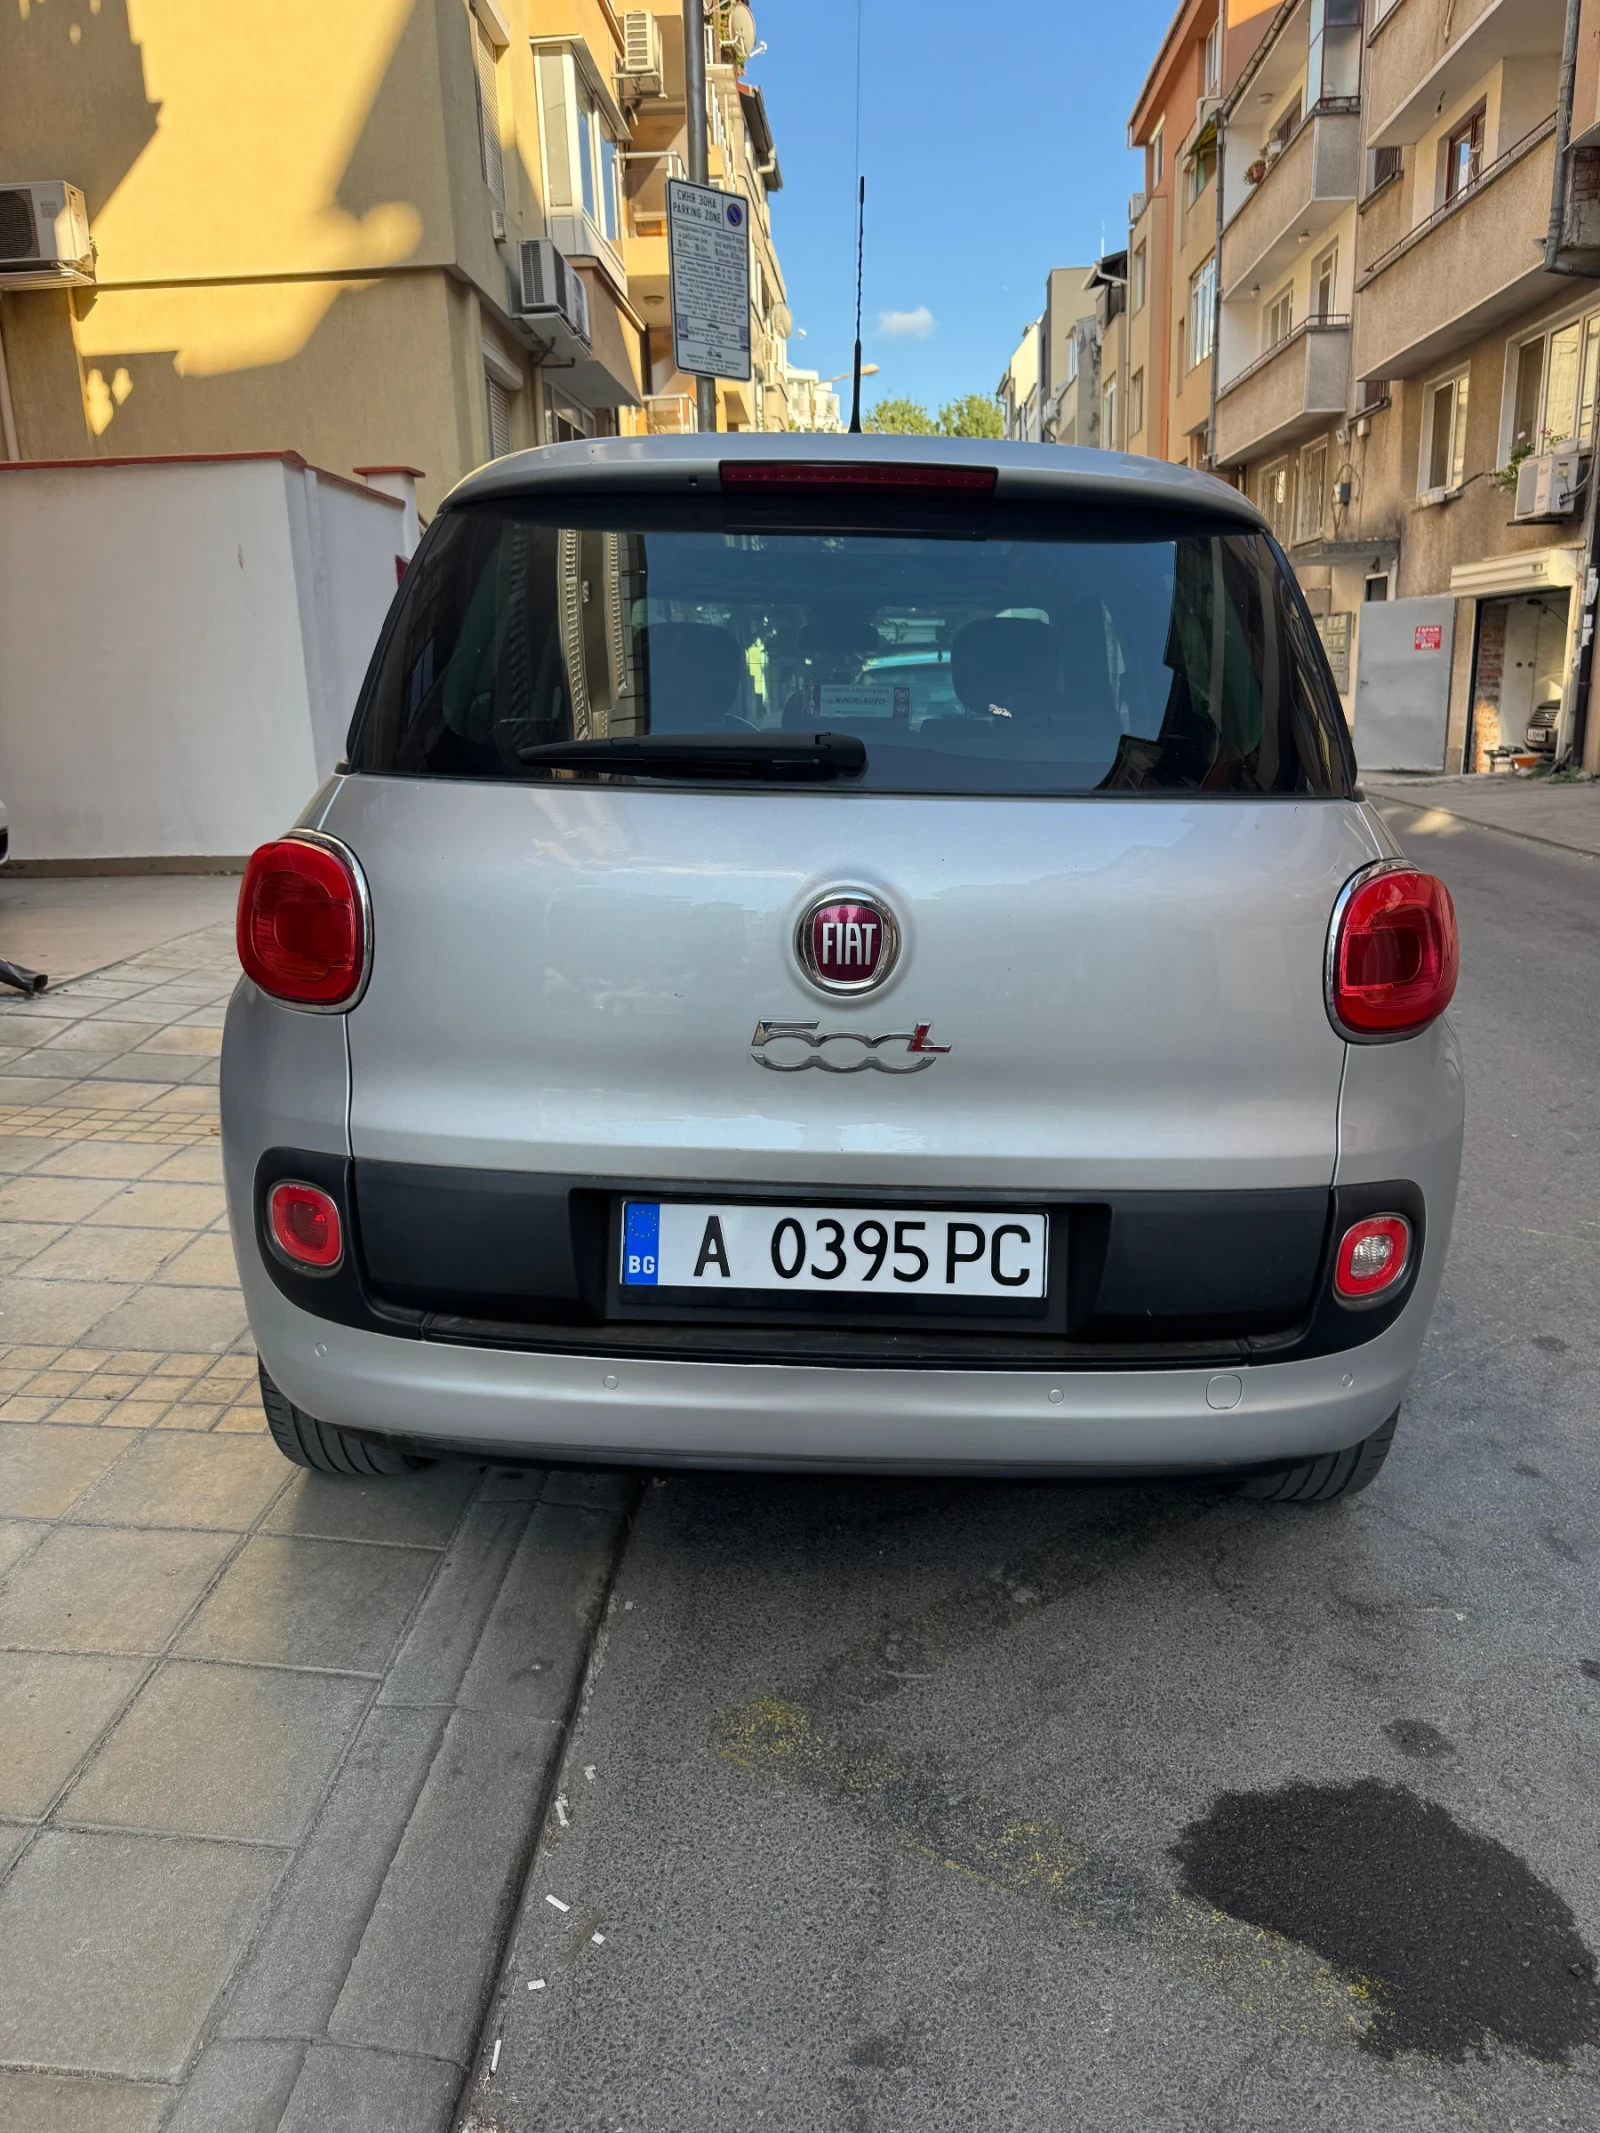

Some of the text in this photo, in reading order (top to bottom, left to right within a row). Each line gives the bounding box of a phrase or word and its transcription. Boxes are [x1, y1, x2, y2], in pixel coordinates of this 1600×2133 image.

[673, 202, 722, 224] PARKING ZONE
[677, 189, 717, 209] СИНЯ ЗОНА
[822, 922, 877, 966] FIAT
[751, 1019, 952, 1074] 500L
[693, 1214, 731, 1278] A
[628, 1255, 656, 1275] BG
